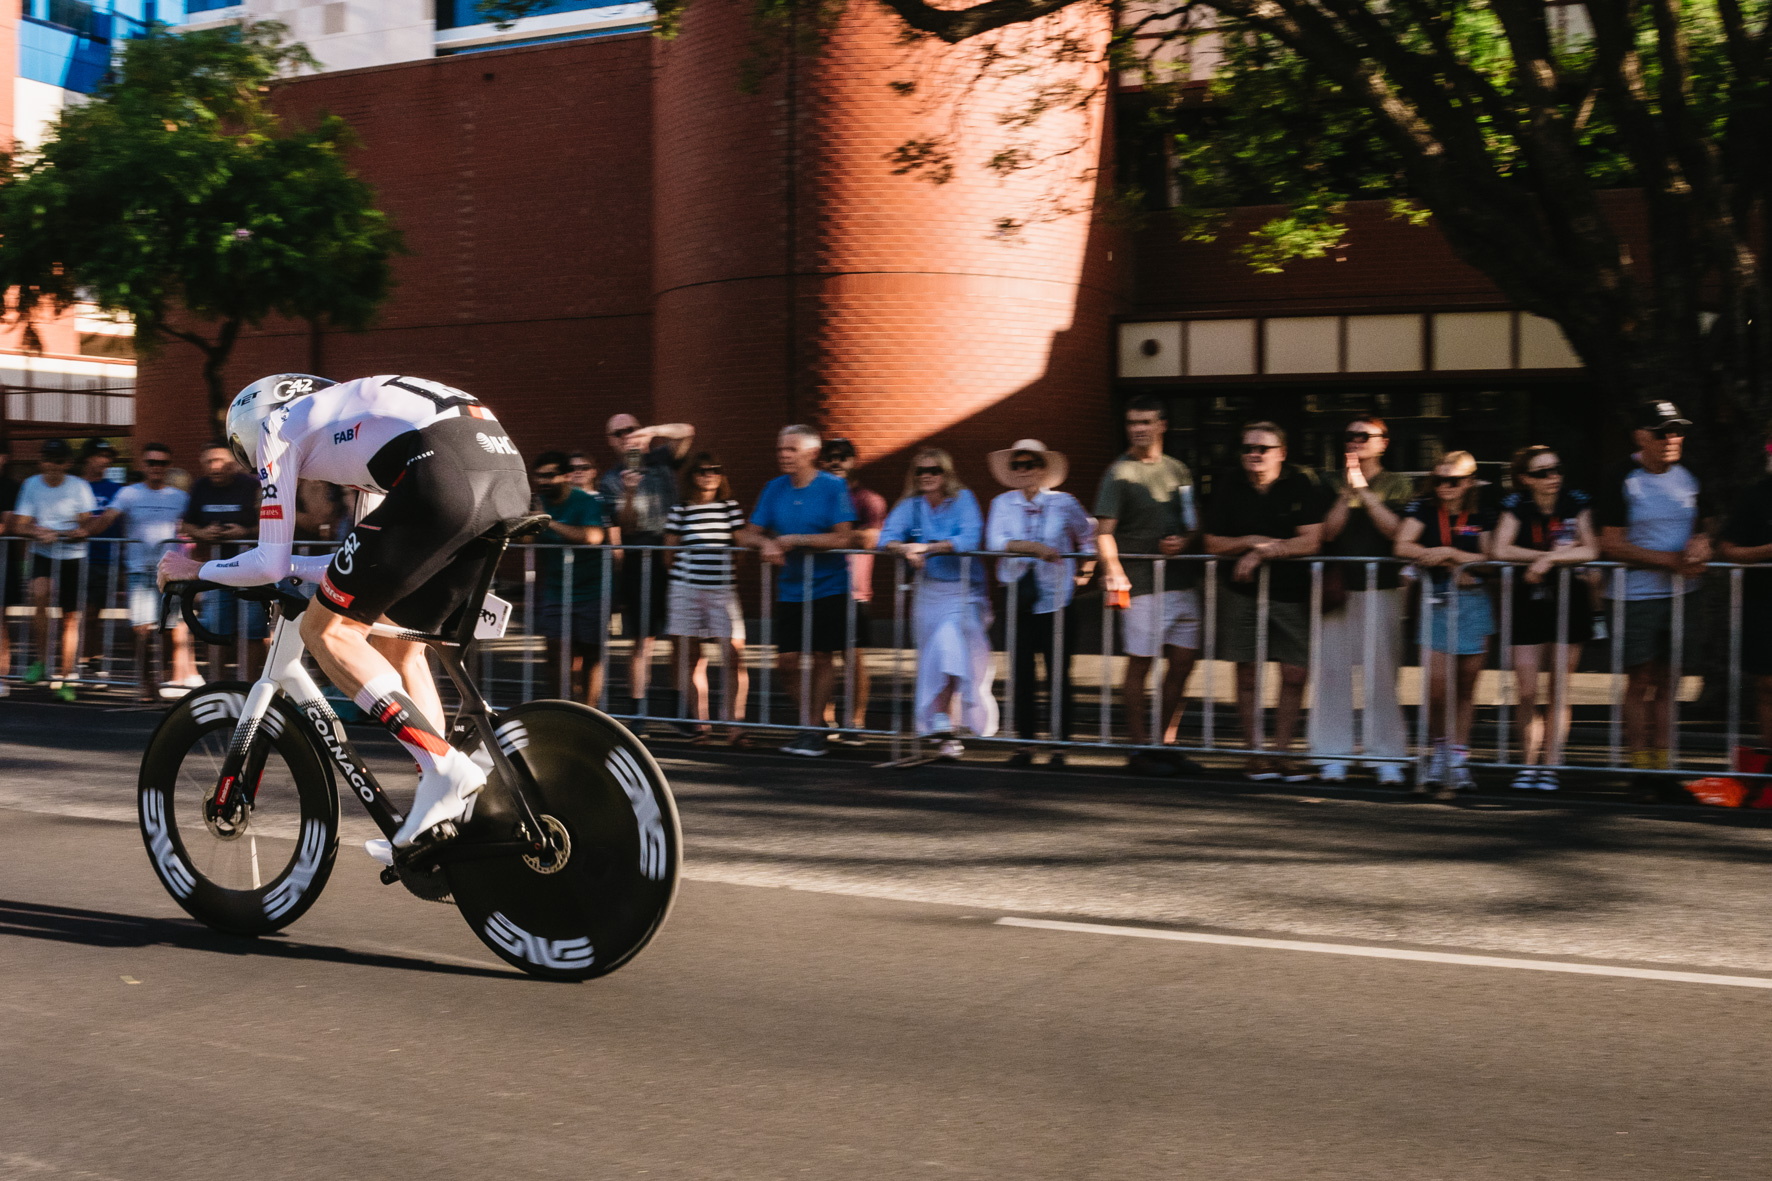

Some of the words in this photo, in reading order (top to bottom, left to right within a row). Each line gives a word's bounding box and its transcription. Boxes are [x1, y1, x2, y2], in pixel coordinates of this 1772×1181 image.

[230, 391, 262, 411] MET
[273, 379, 313, 401] G42
[335, 532, 361, 575] G42
[306, 707, 375, 803] COLNAGO
